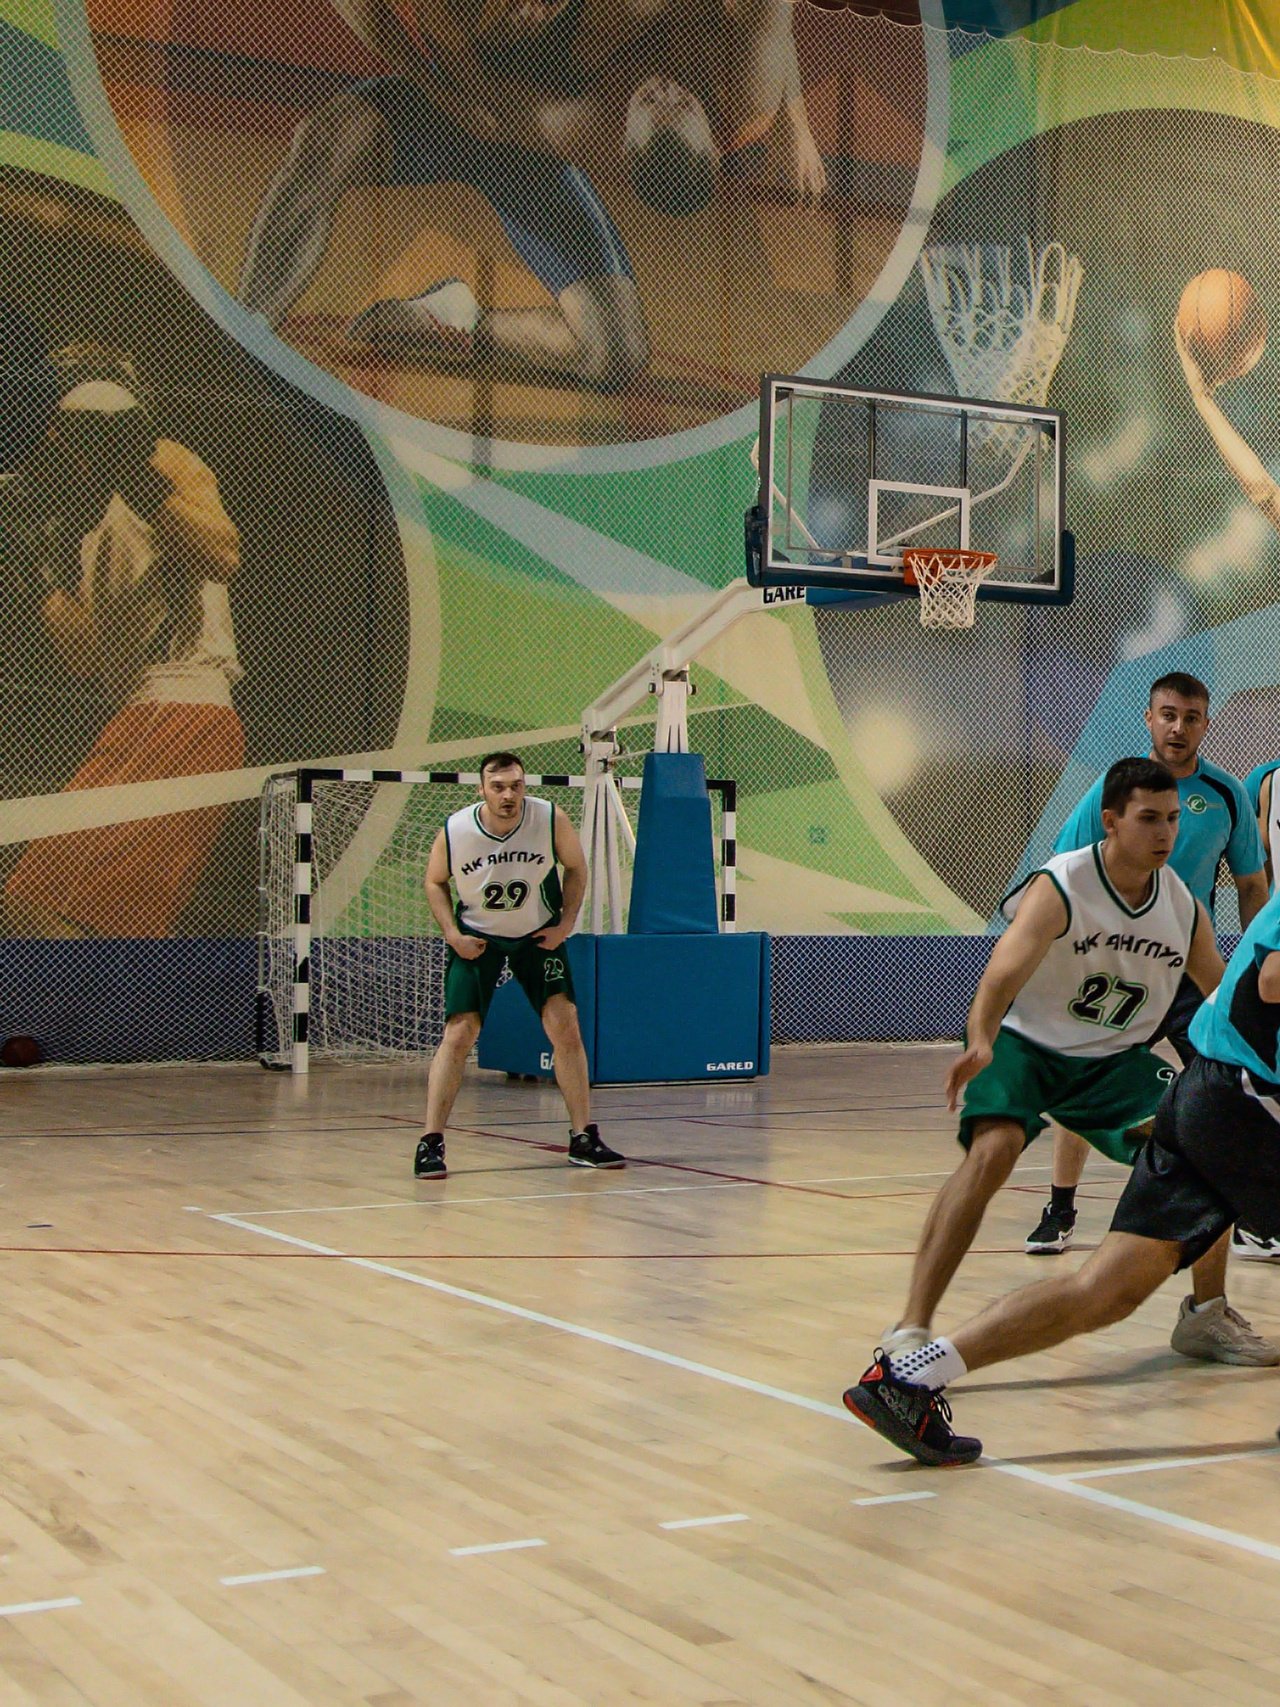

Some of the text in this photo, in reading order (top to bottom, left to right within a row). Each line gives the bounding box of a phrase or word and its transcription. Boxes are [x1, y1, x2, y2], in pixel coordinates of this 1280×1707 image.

[763, 586, 806, 604] GARE
[461, 856, 483, 876] НК
[482, 879, 531, 912] 29
[1073, 931, 1102, 955] НК
[1067, 971, 1149, 1031] 27
[706, 1061, 754, 1072] GARED
